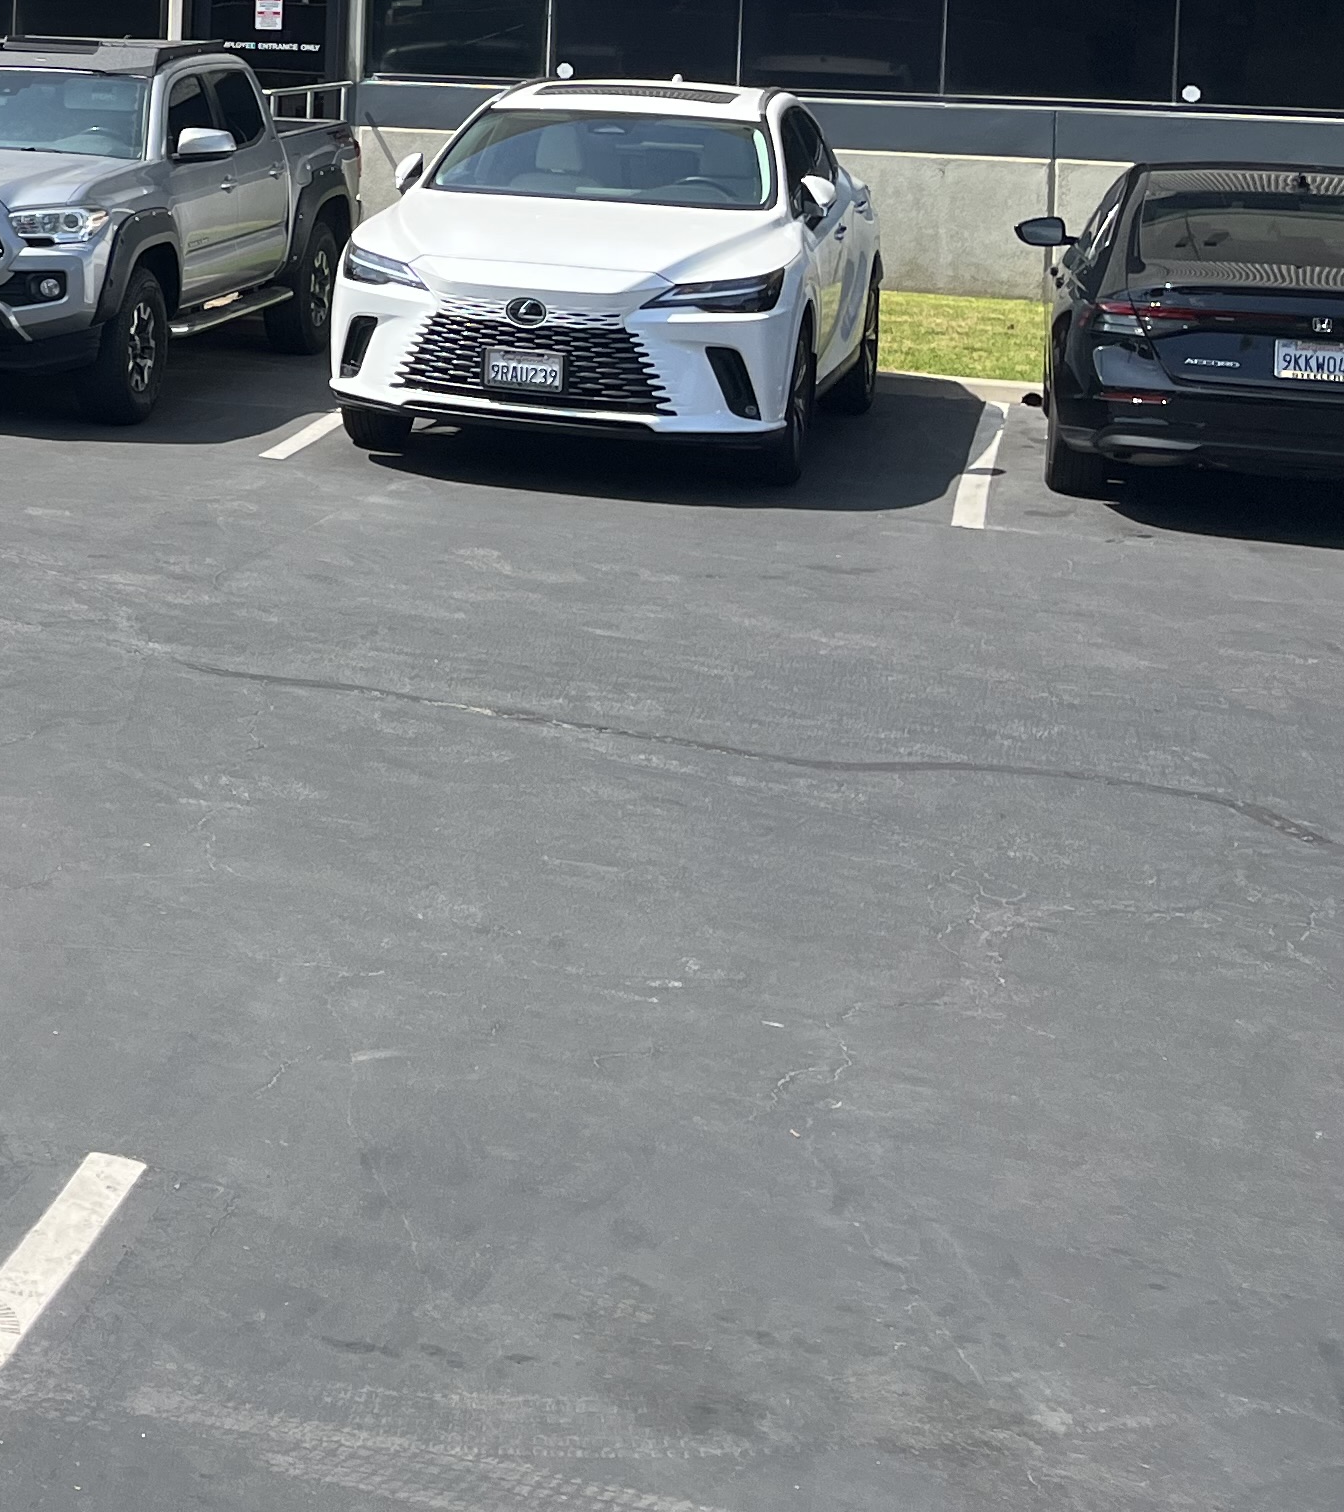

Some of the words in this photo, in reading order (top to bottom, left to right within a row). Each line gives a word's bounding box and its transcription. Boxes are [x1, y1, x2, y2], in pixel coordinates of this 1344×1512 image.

[258, 42, 299, 51] ENTRANCE
[300, 44, 321, 52] ONLY
[491, 364, 558, 385] 9RAU239
